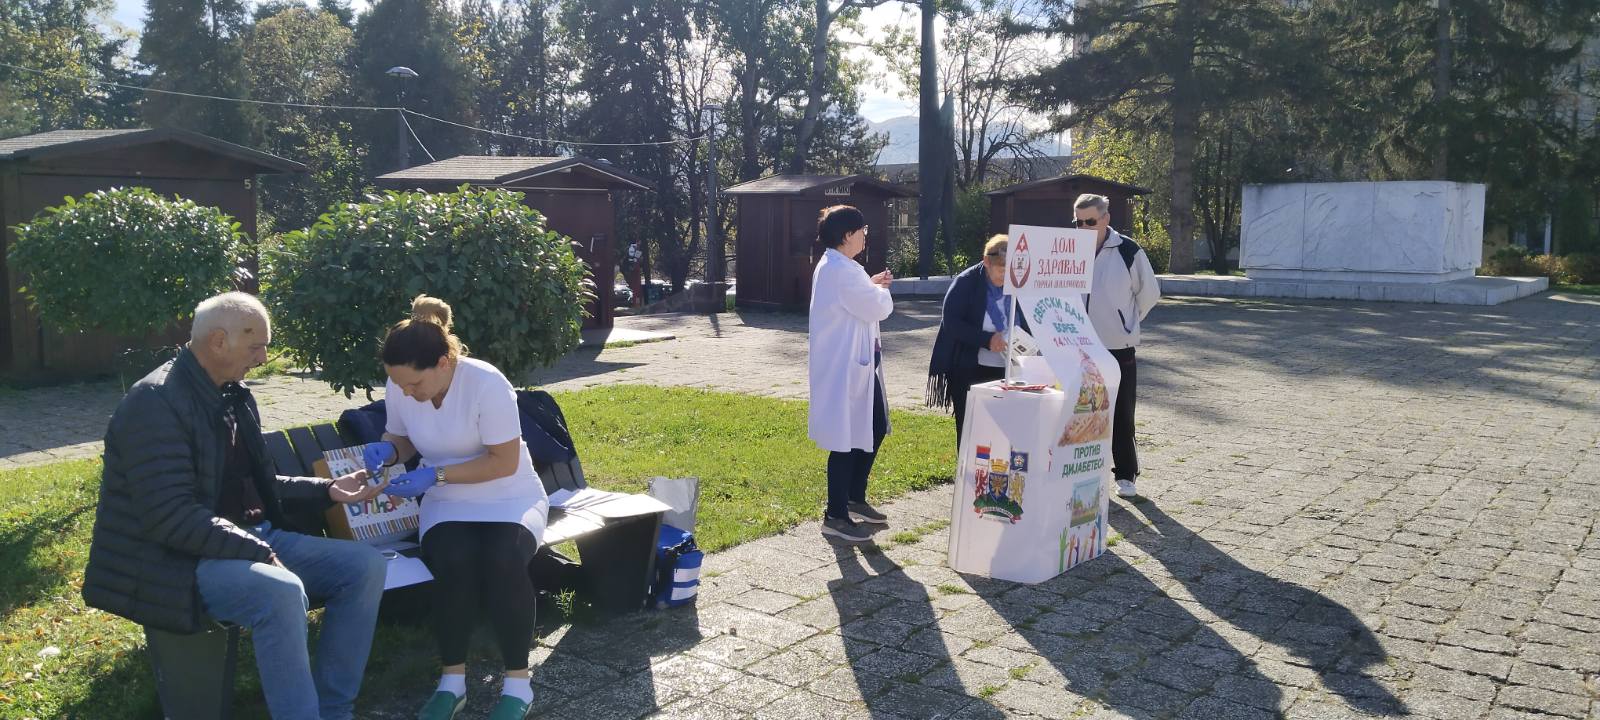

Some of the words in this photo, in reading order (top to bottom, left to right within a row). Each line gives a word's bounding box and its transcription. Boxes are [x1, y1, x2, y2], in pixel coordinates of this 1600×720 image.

[244, 178, 252, 190] 5
[1051, 237, 1076, 255] ДОМ
[1037, 258, 1086, 277] ЗДРАВЉА
[1033, 296, 1063, 325] СВЕТСКИ
[1064, 301, 1085, 325] ДАН
[1073, 443, 1101, 460] ПРОТИВ
